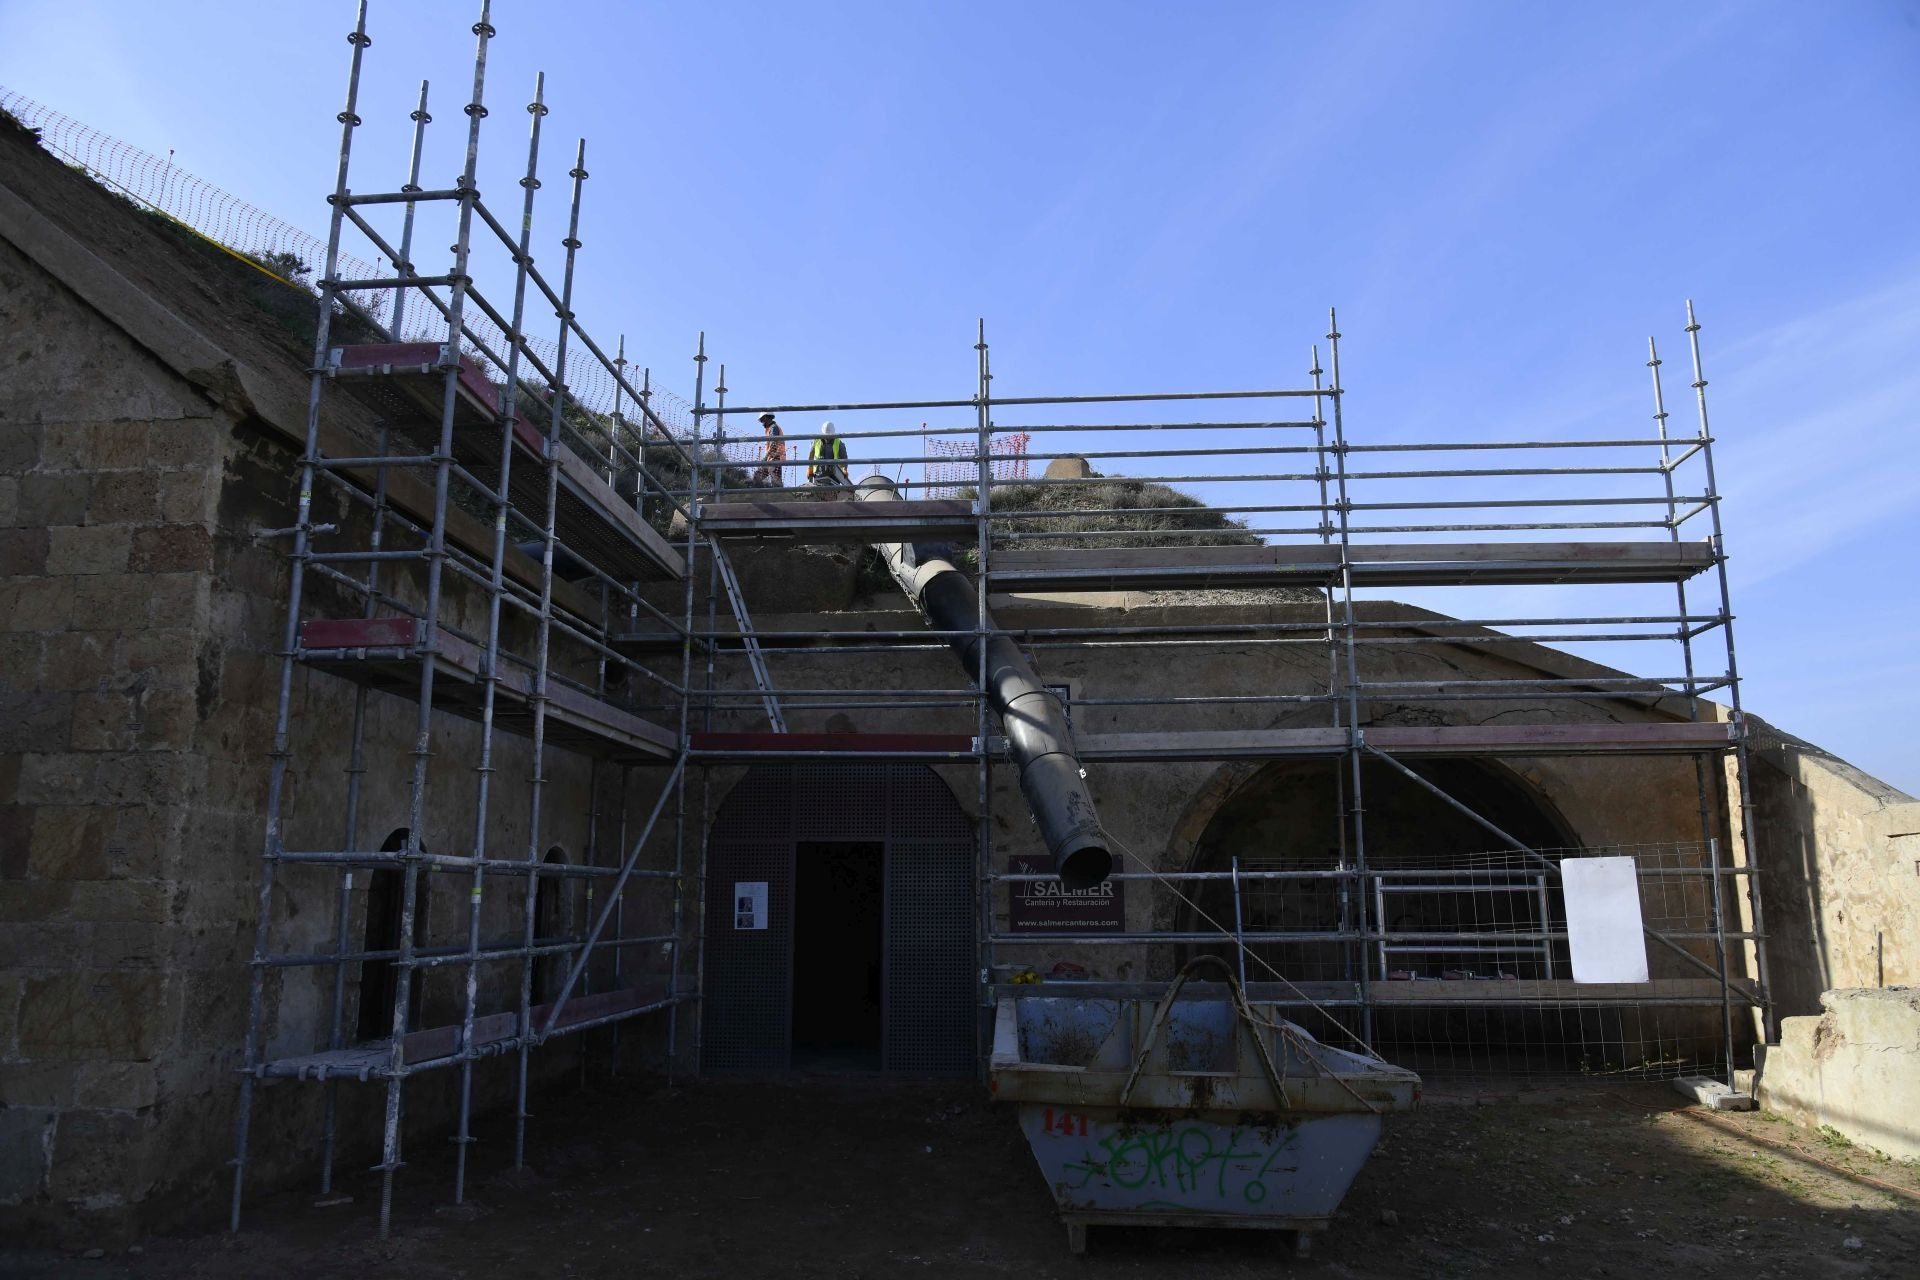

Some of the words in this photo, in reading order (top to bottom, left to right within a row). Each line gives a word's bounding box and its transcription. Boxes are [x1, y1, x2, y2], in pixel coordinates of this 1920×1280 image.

[1062, 898, 1110, 906] Restauración
[1017, 919, 1119, 927] www.salmercanteros.com
[1042, 1104, 1089, 1136] 141
